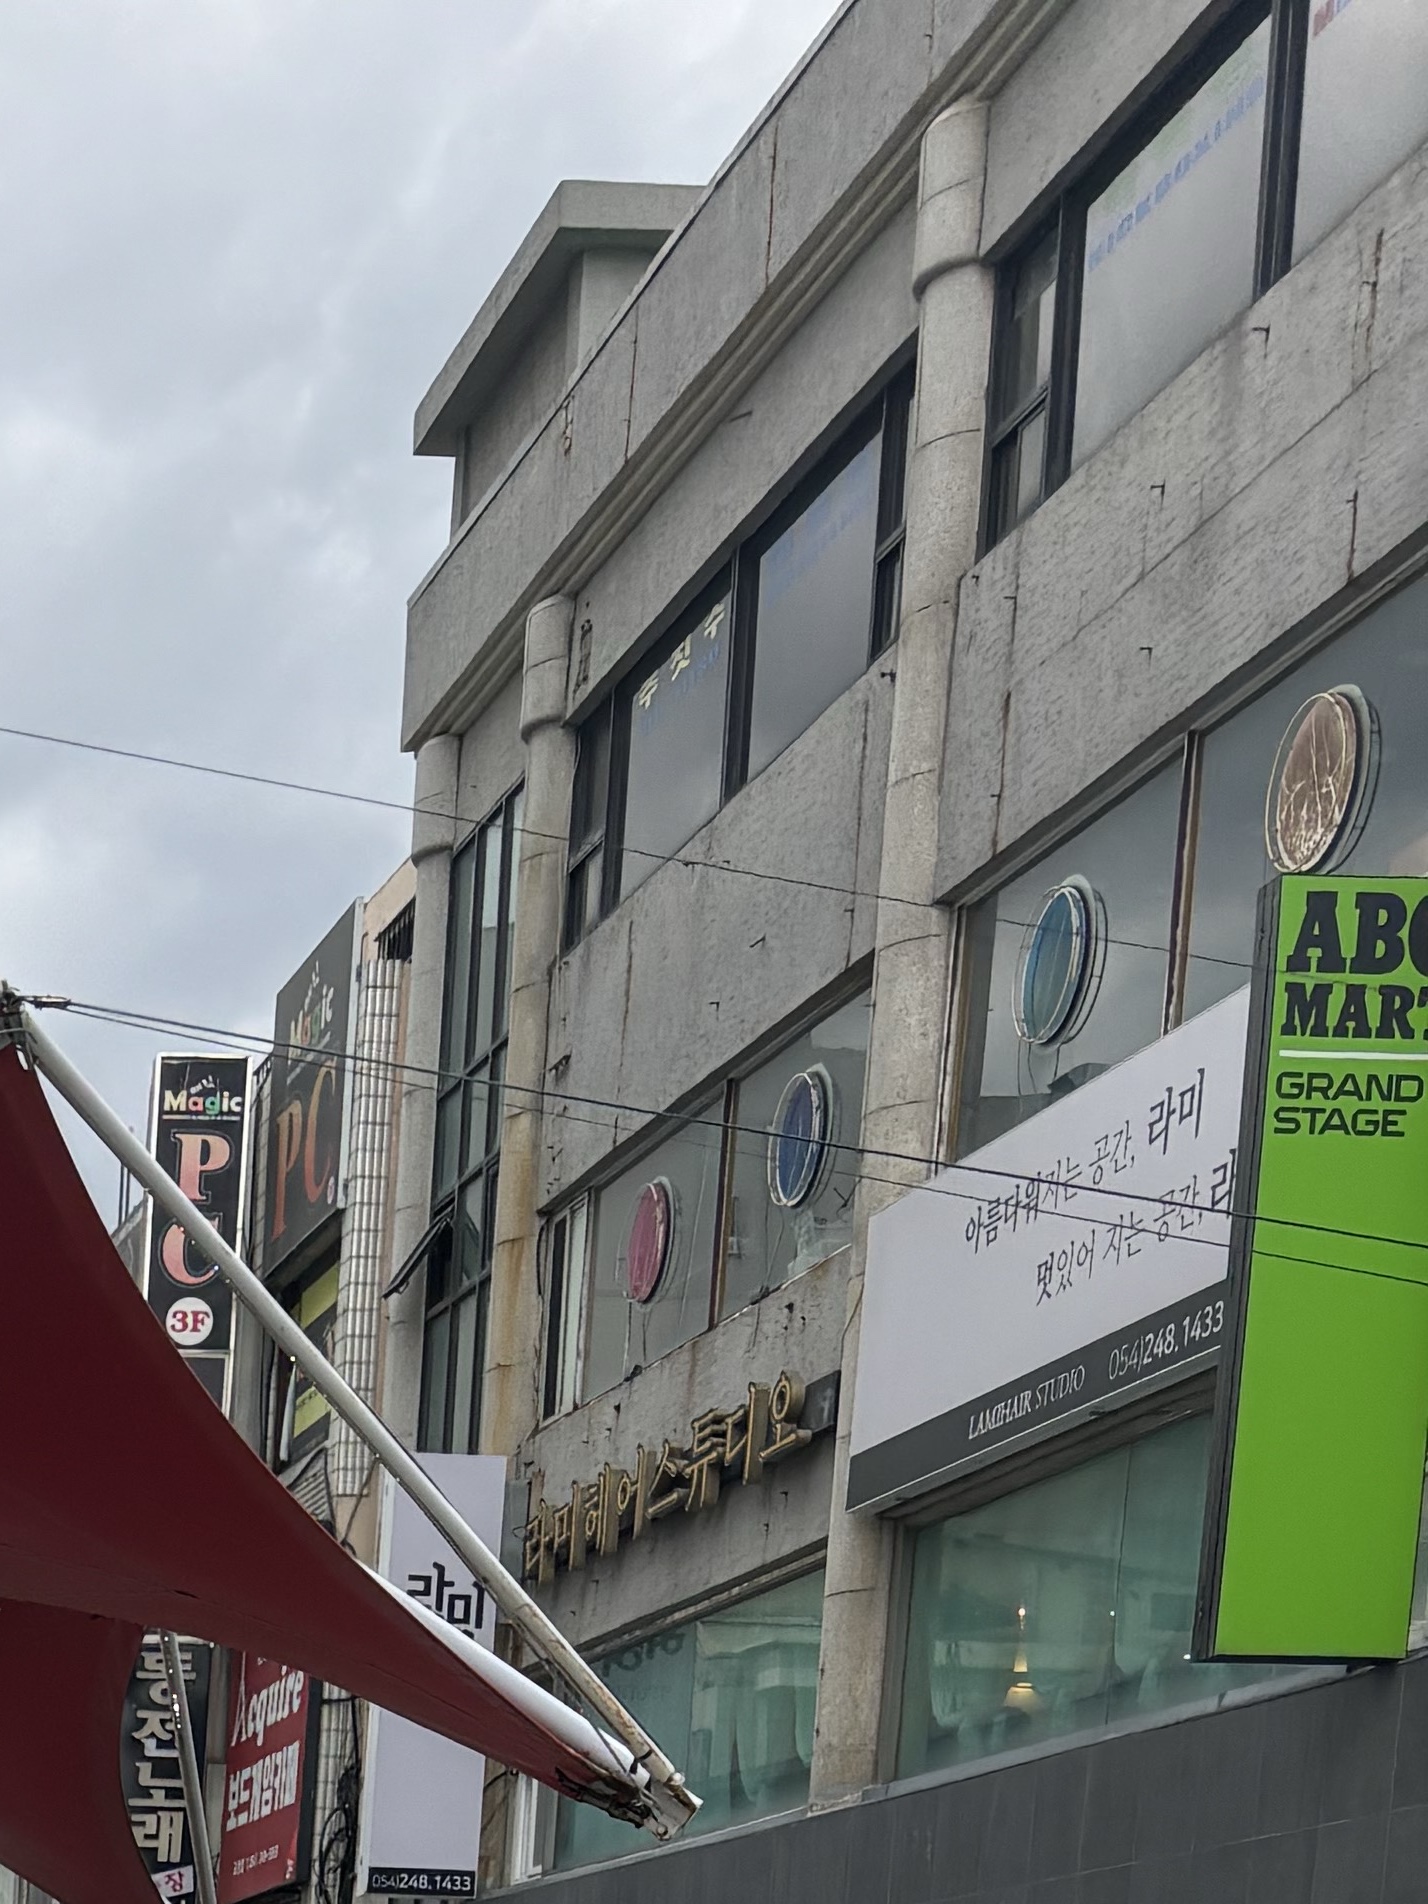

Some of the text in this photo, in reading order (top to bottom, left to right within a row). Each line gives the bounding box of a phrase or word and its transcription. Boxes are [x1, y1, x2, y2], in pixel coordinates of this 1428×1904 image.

[1275, 1071, 1425, 1102] GRAND
[163, 1089, 243, 1116] Magic
[1148, 1068, 1205, 1155] 라미
[1273, 1107, 1406, 1136] STAGE
[170, 1310, 211, 1334] 3F
[1035, 1364, 1086, 1409] STUDIO
